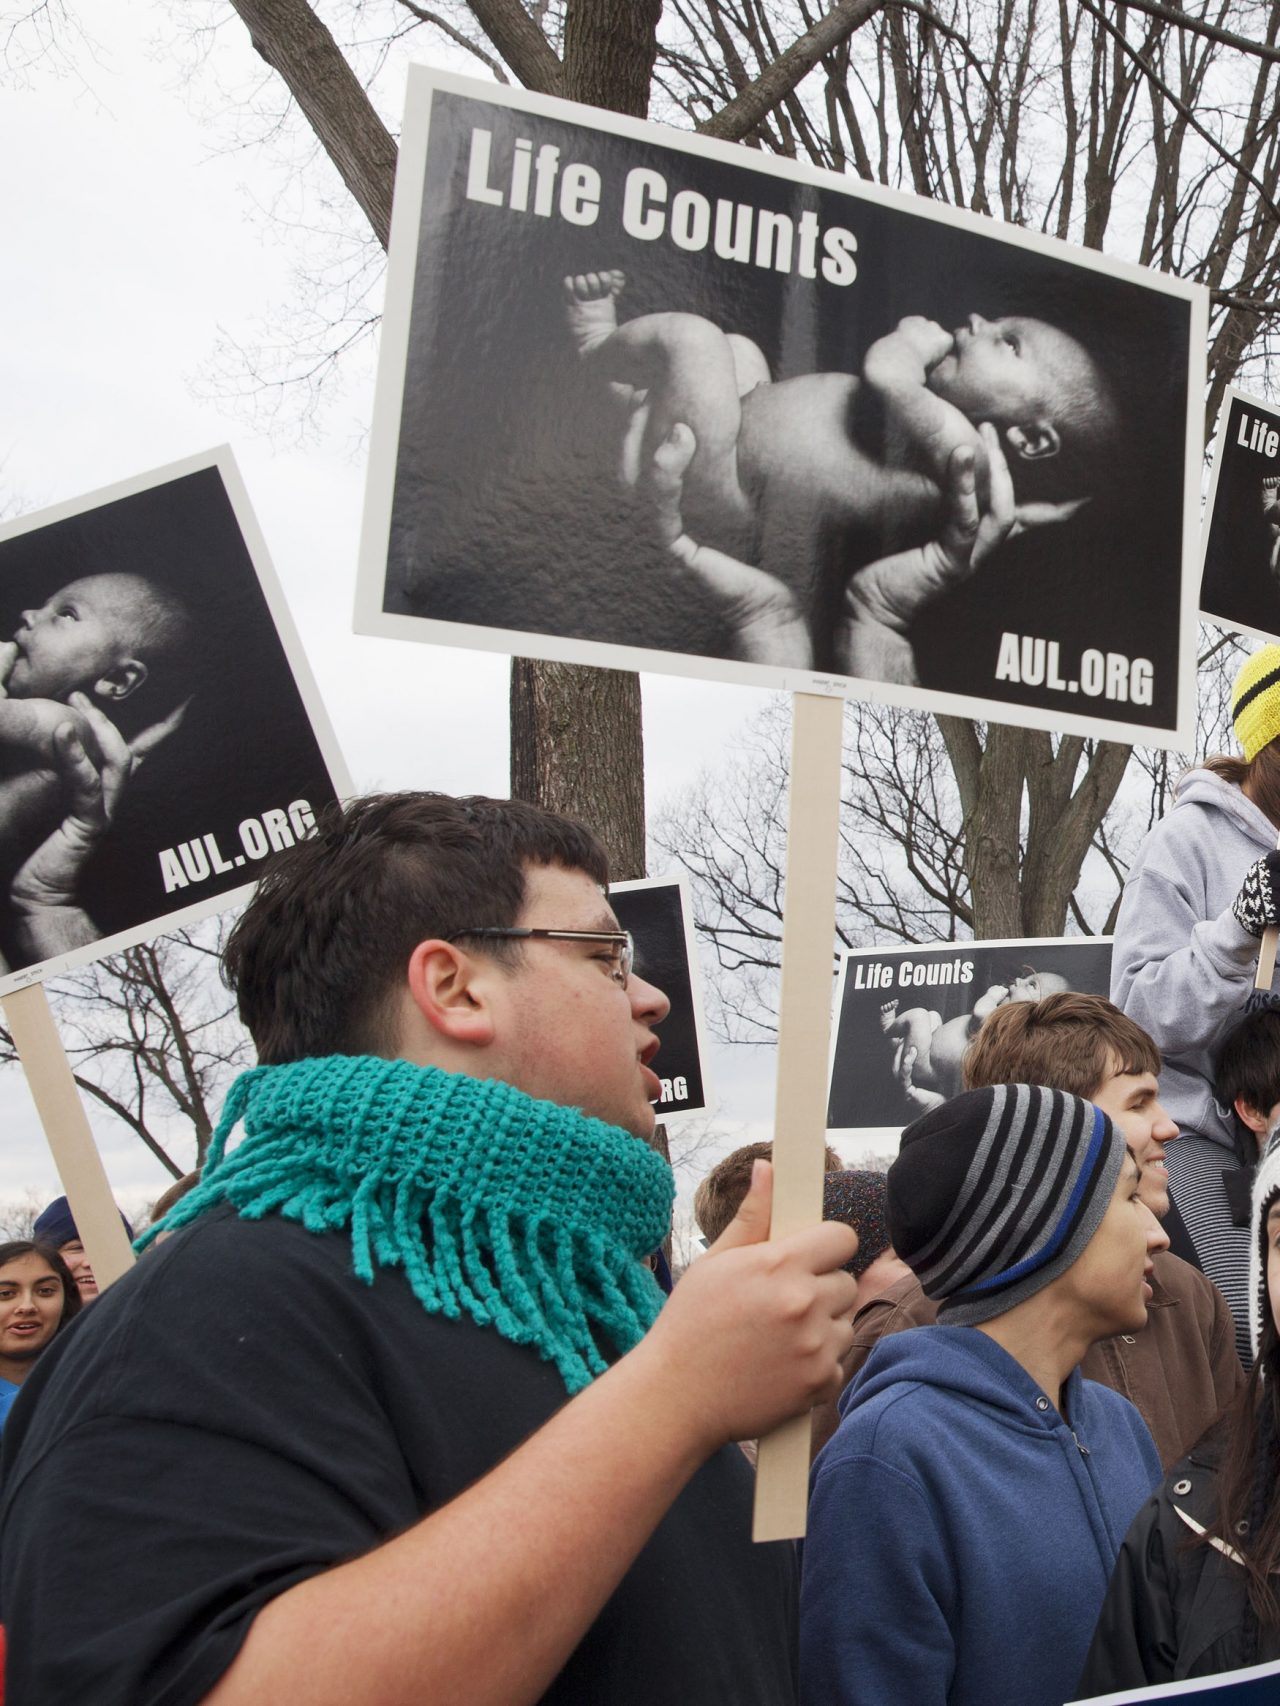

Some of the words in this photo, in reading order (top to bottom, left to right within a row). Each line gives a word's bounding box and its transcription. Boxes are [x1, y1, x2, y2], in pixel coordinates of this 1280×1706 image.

[466, 127, 601, 226] Life
[622, 167, 859, 287] Counts
[1237, 413, 1280, 458] Life
[995, 632, 1154, 706] AUL.ORG
[158, 799, 319, 894] AUL.ORG
[854, 962, 894, 990] Life
[898, 958, 975, 987] Counts
